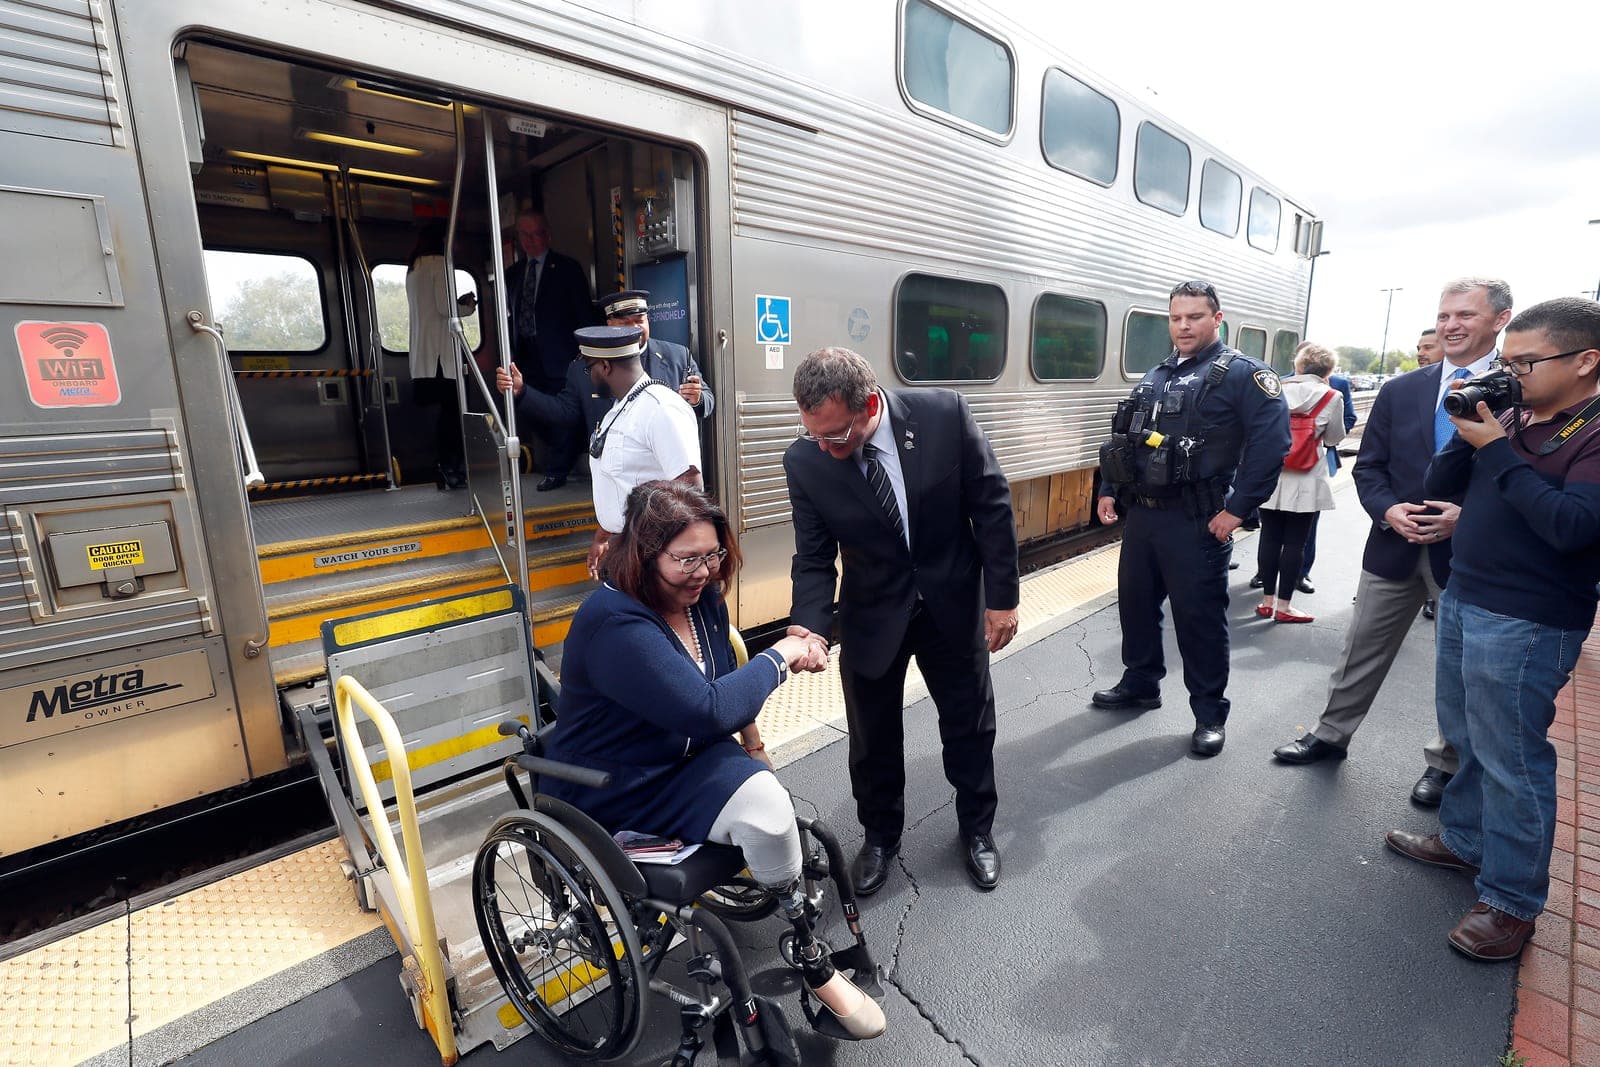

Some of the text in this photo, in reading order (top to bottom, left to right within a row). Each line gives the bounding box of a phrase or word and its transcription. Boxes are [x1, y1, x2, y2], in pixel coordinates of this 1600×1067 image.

[44, 359, 98, 378] WiFi
[52, 380, 98, 388] ONBOARD
[59, 387, 90, 397] Metra
[1560, 417, 1585, 439] Nikon
[91, 543, 138, 556] CAUTION
[93, 552, 140, 563] DOOR OPENS
[321, 543, 417, 565] WATCH YOUR STEP
[102, 559, 133, 568] QUICKLY
[26, 669, 145, 722] Metra
[84, 700, 145, 719] OWNER
